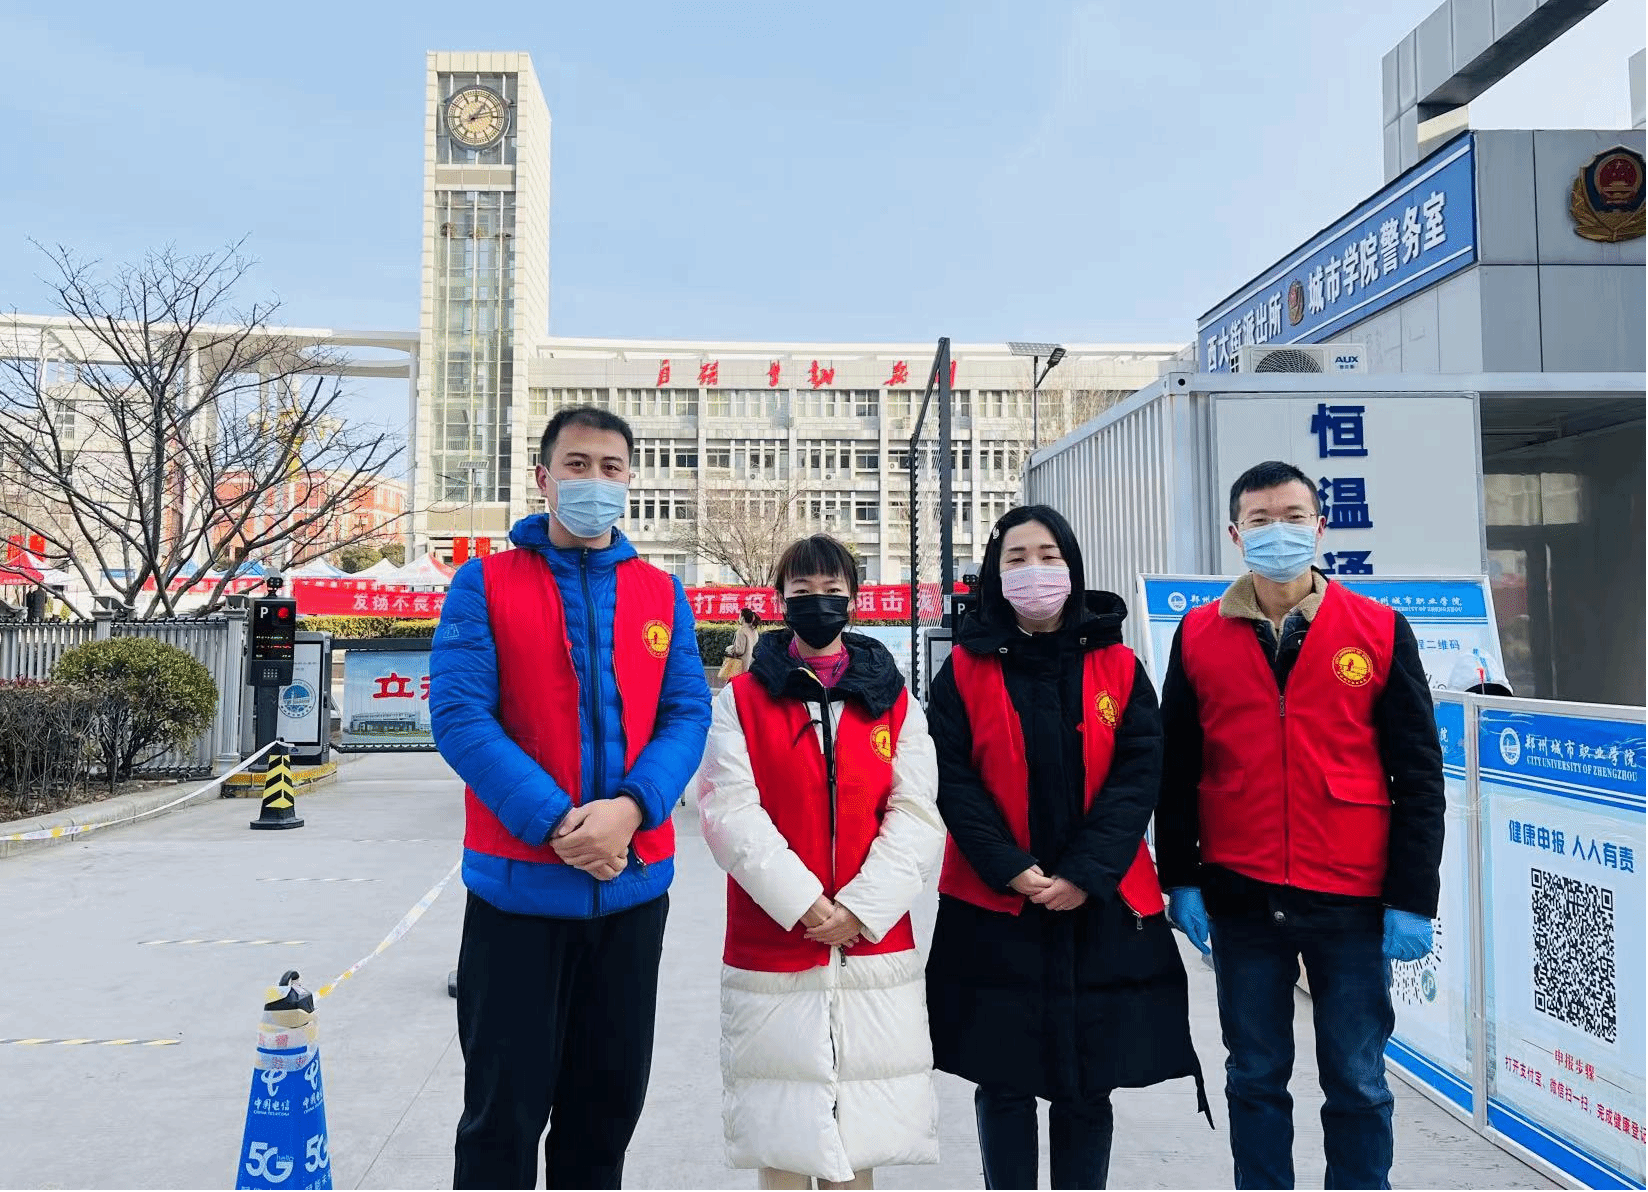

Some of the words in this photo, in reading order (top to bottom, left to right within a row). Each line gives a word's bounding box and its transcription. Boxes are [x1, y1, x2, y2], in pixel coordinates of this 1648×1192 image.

[1309, 191, 1446, 314] 城市学院警务室
[260, 607, 268, 618] P
[958, 603, 965, 614] P
[1369, 595, 1463, 607] 州城市职业学院
[1525, 734, 1637, 767] 郑州城市职业学院
[1527, 756, 1541, 766] CITY
[1542, 757, 1581, 773] UNIVERSITY
[1583, 764, 1592, 774] OF
[1593, 766, 1637, 782] ZHENGZHOU
[1509, 820, 1564, 855] 健康申报
[1572, 835, 1634, 873] 人人有责
[1554, 1049, 1595, 1081] 申报步骤
[254, 1097, 290, 1112] 中国电信
[246, 1141, 293, 1183] 5G
